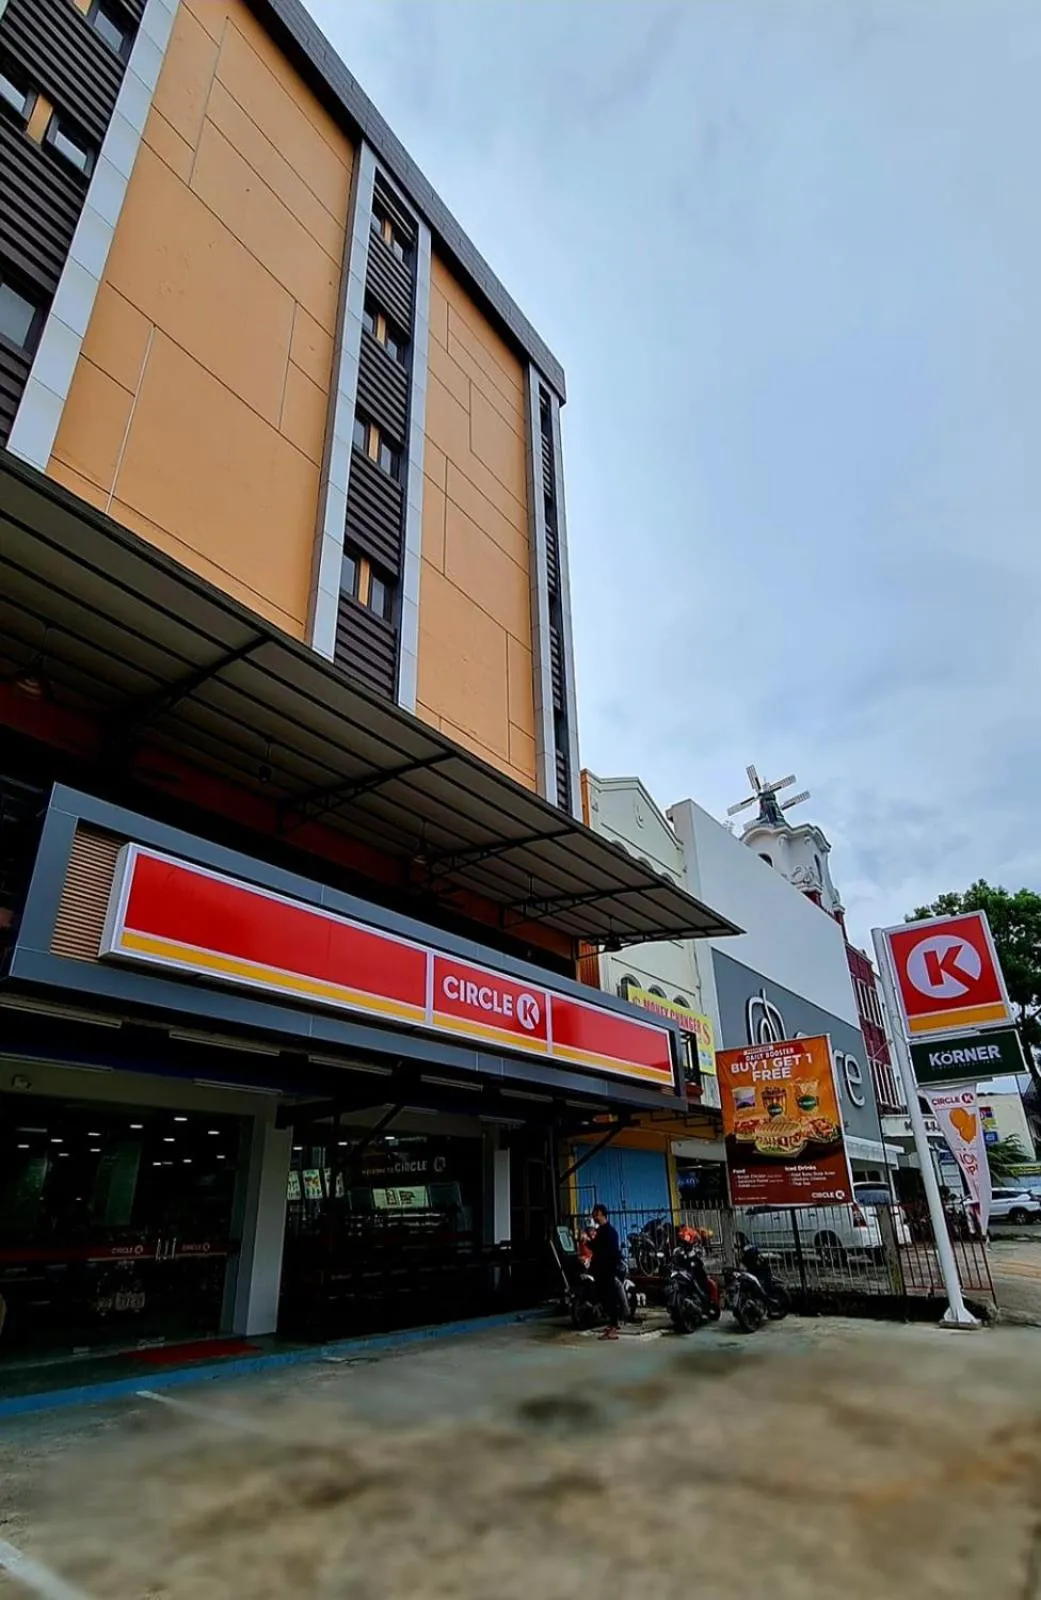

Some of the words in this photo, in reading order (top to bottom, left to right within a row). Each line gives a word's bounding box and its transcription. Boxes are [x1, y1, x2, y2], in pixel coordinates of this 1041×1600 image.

[443, 976, 513, 1016] CIRCLE
[766, 1047, 795, 1059] BOOSTER
[929, 1045, 1001, 1066] KÖRNER
[731, 1060, 758, 1073] BUY
[762, 1060, 768, 1070] 1
[772, 1054, 802, 1068] GET
[805, 1053, 812, 1064] 1
[752, 1067, 792, 1082] FREE
[931, 1096, 960, 1105] CIRCLE
[395, 1160, 427, 1172] CIRCLE
[811, 1191, 834, 1199] CIRCLE
